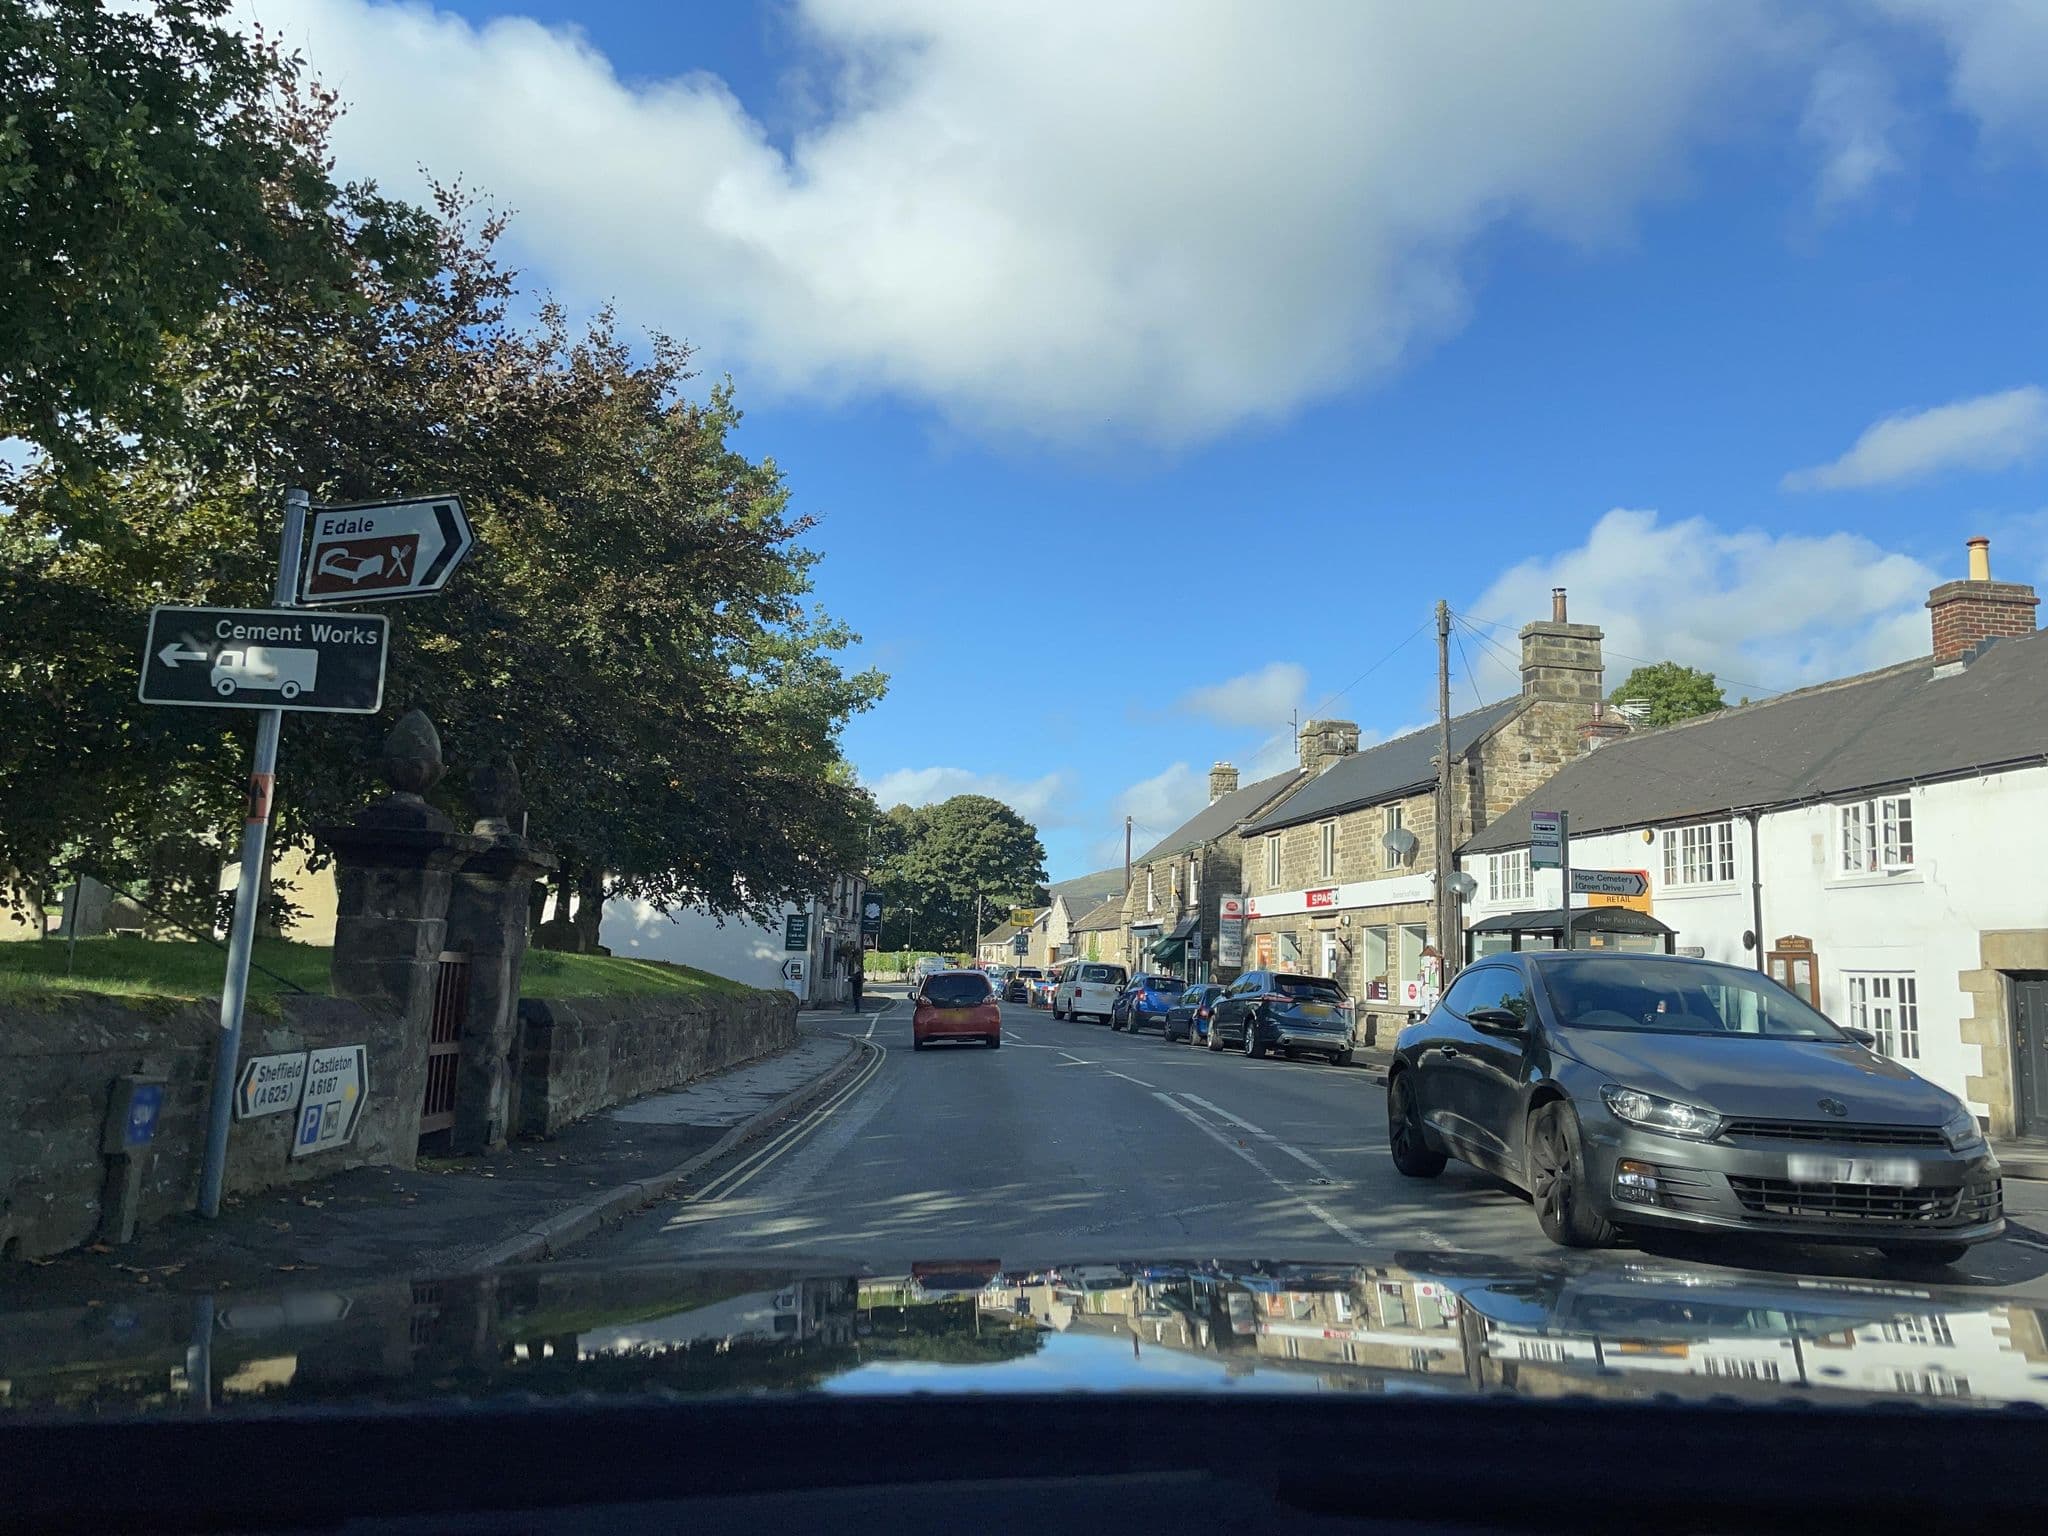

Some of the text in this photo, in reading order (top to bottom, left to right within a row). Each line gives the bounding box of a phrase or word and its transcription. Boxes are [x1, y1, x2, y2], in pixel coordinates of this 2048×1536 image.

[322, 517, 374, 535] Edale
[216, 619, 378, 645] Cement Works
[1575, 873, 1633, 884] Hope Cemetery
[1575, 881, 1625, 892] (Green Drive)
[1311, 893, 1333, 906] SPAR
[1606, 895, 1632, 903] RETAIL
[258, 1061, 302, 1083] Sheffield
[312, 1056, 352, 1075] Castleton
[303, 1106, 318, 1140] P
